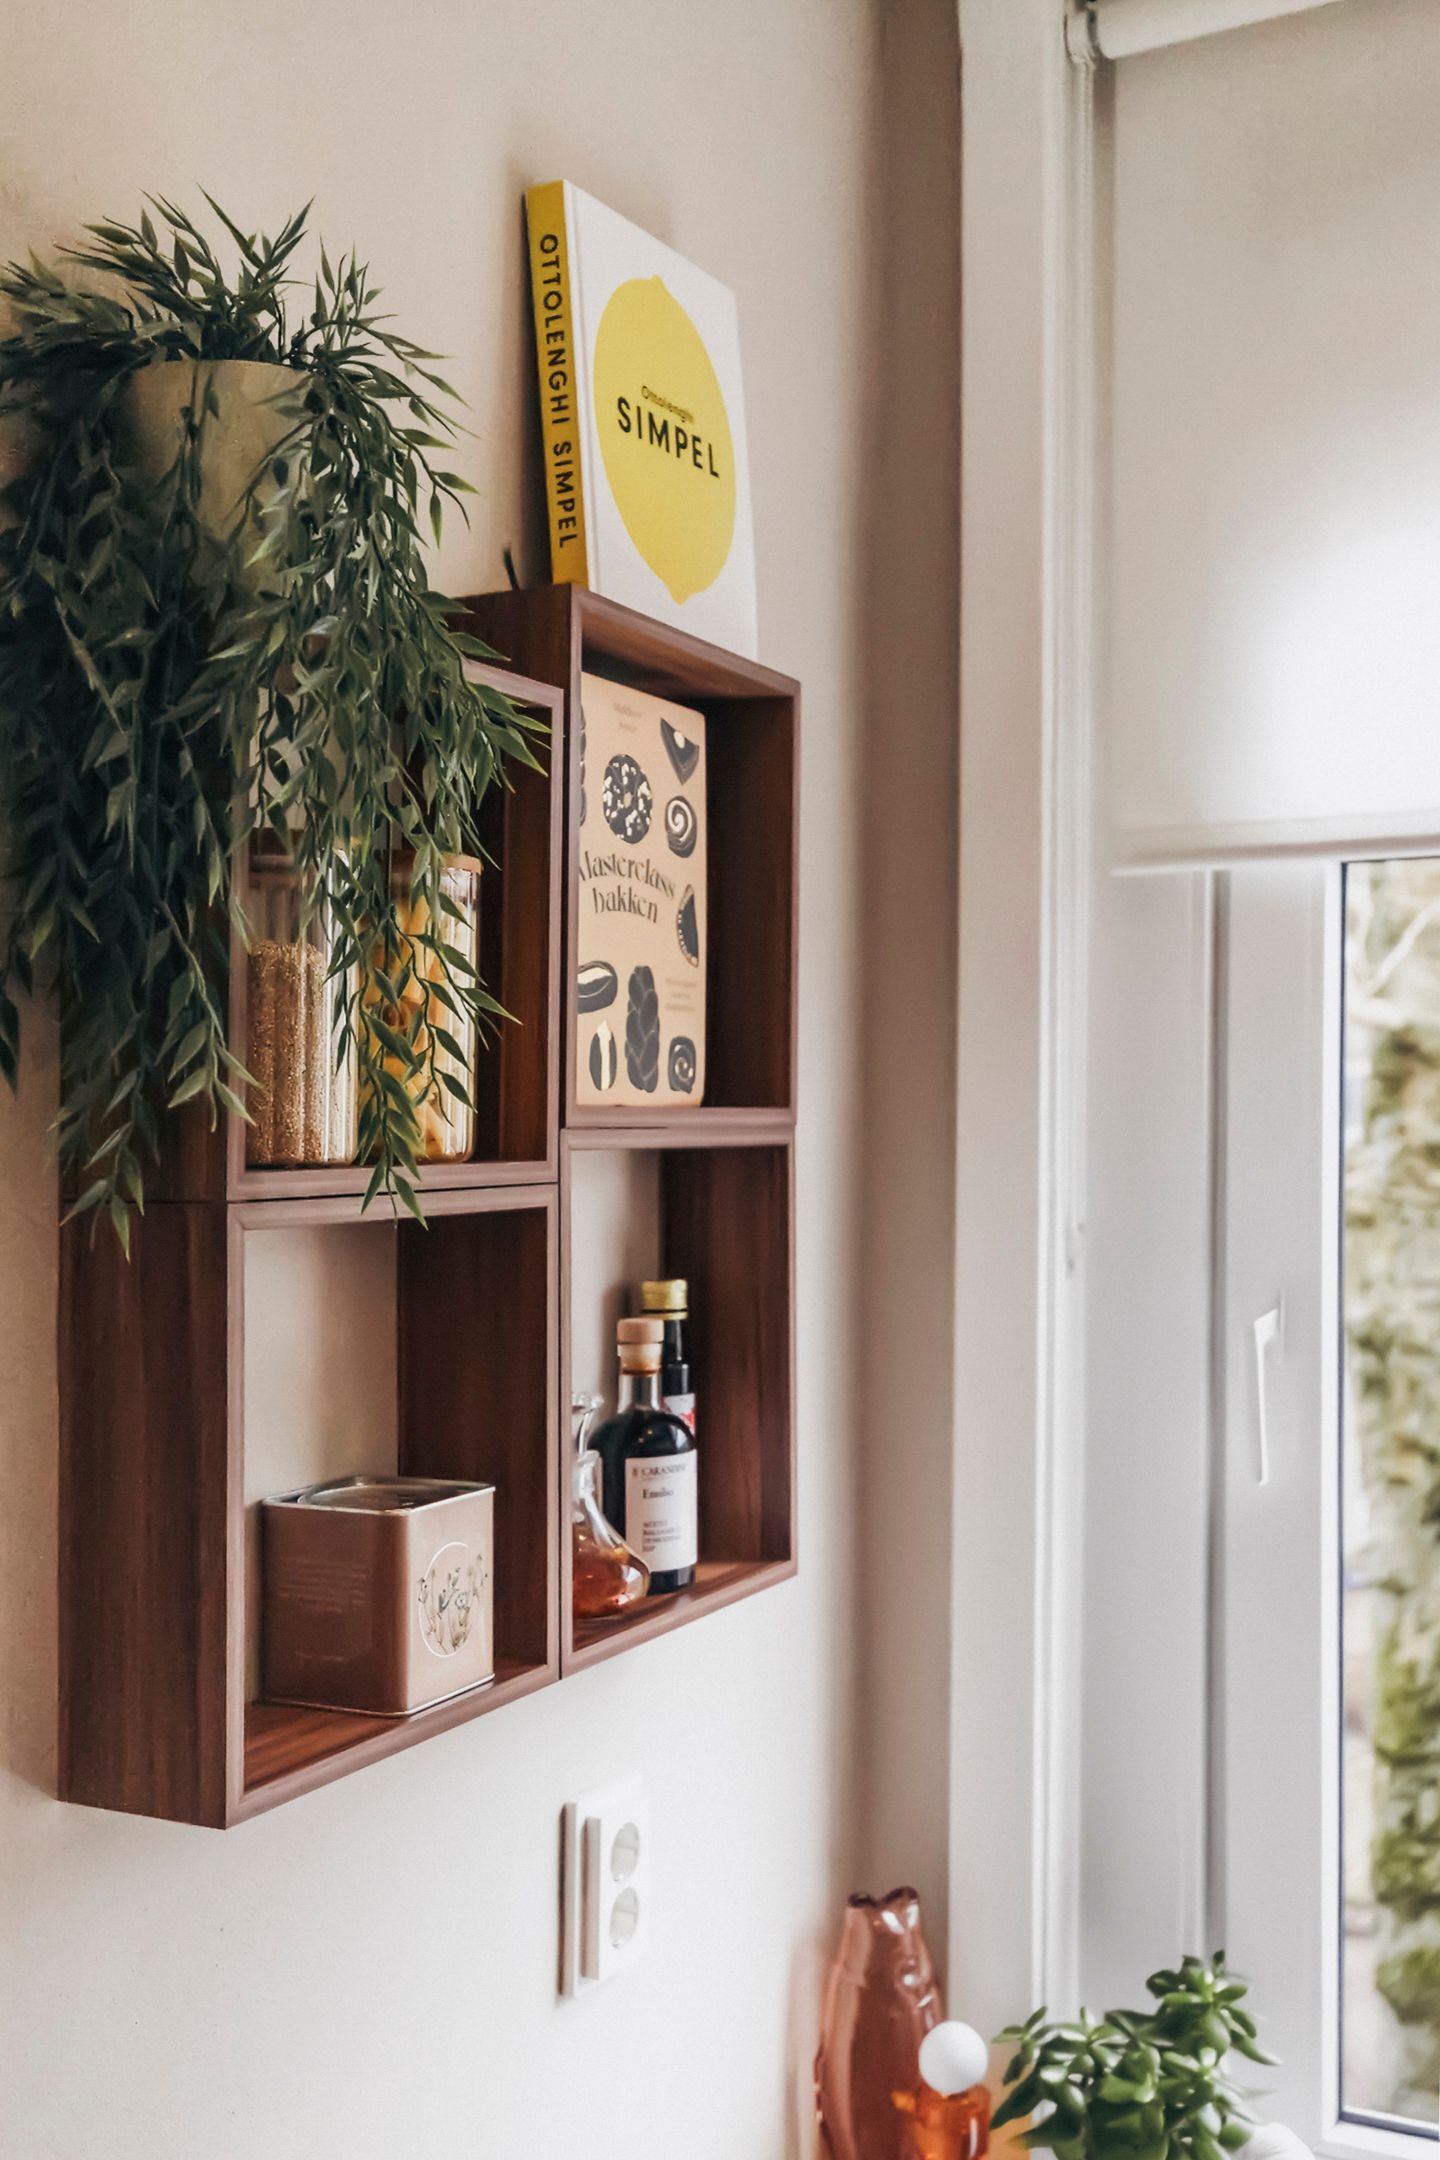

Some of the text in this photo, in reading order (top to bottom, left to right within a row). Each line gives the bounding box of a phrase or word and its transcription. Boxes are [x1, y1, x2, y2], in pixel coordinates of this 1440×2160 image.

[539, 233, 578, 549] OTTOLENGHI SIMPEL
[617, 396, 720, 478] SIMPEL
[592, 885, 657, 924] bakken
